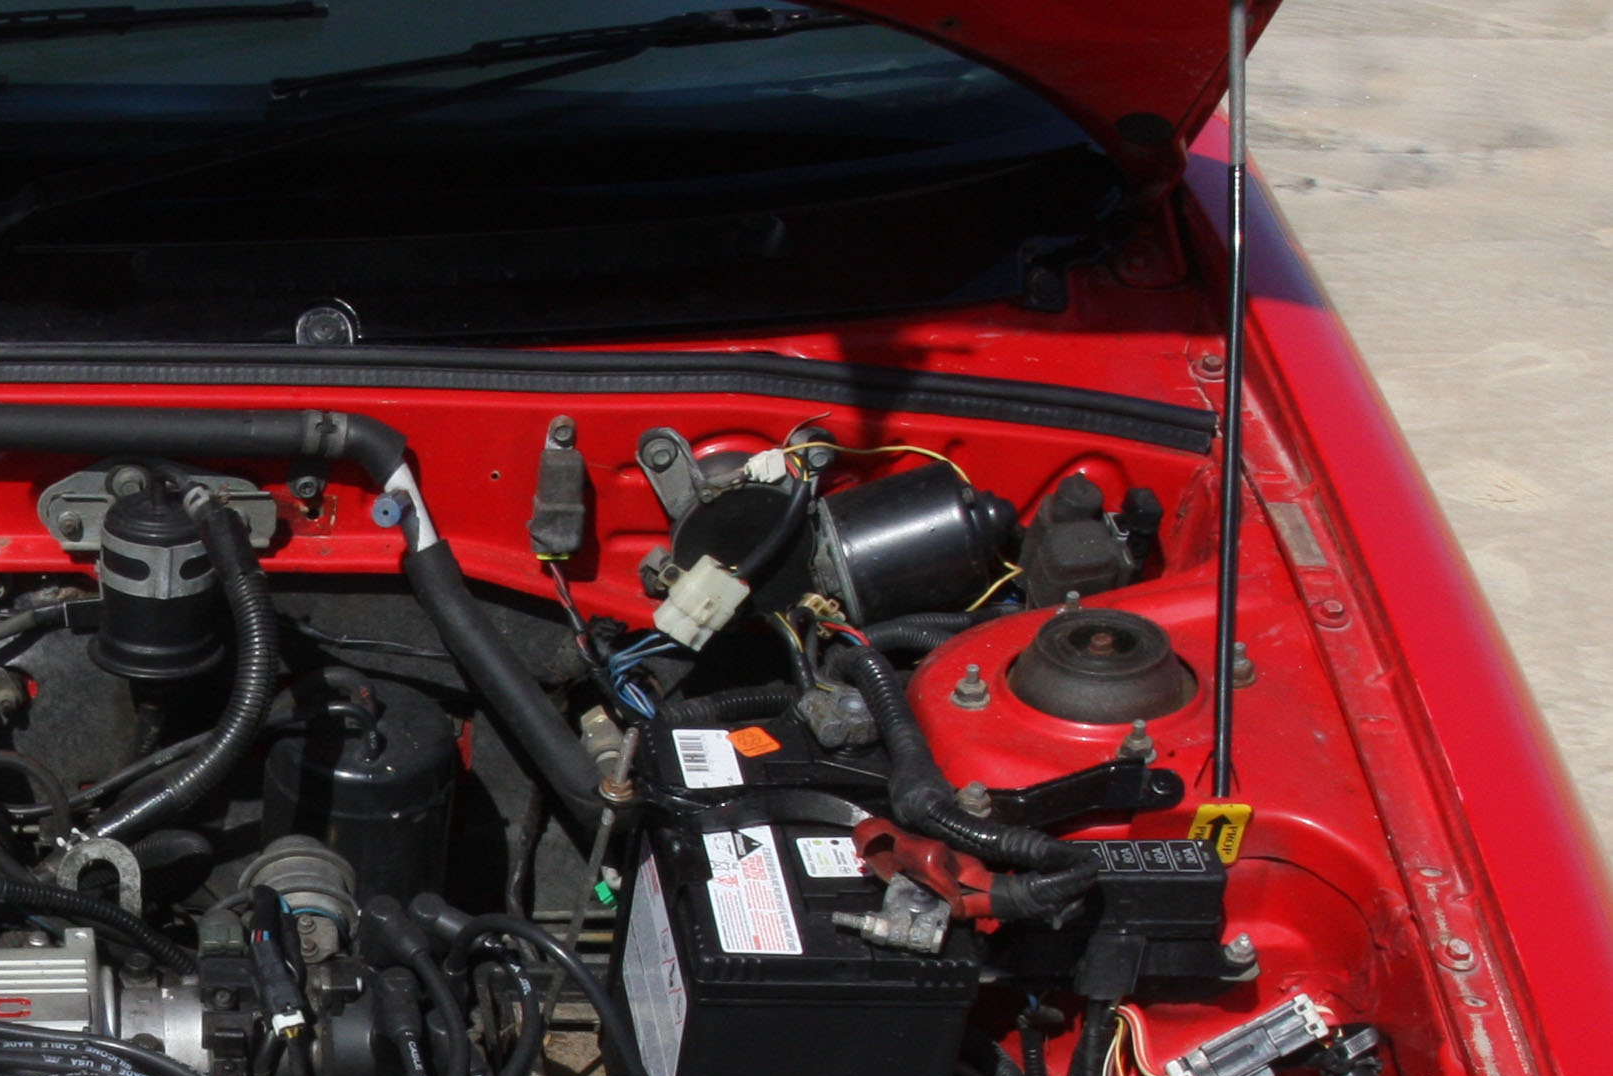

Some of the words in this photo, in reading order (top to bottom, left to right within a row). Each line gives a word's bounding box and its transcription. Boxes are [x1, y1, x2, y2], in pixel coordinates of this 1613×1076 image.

[1222, 826, 1238, 855] PROP
[41, 1041, 78, 1050] CABLE
[408, 1040, 423, 1071] CABLE
[70, 1057, 94, 1068] USA
[100, 1063, 112, 1071] IN
